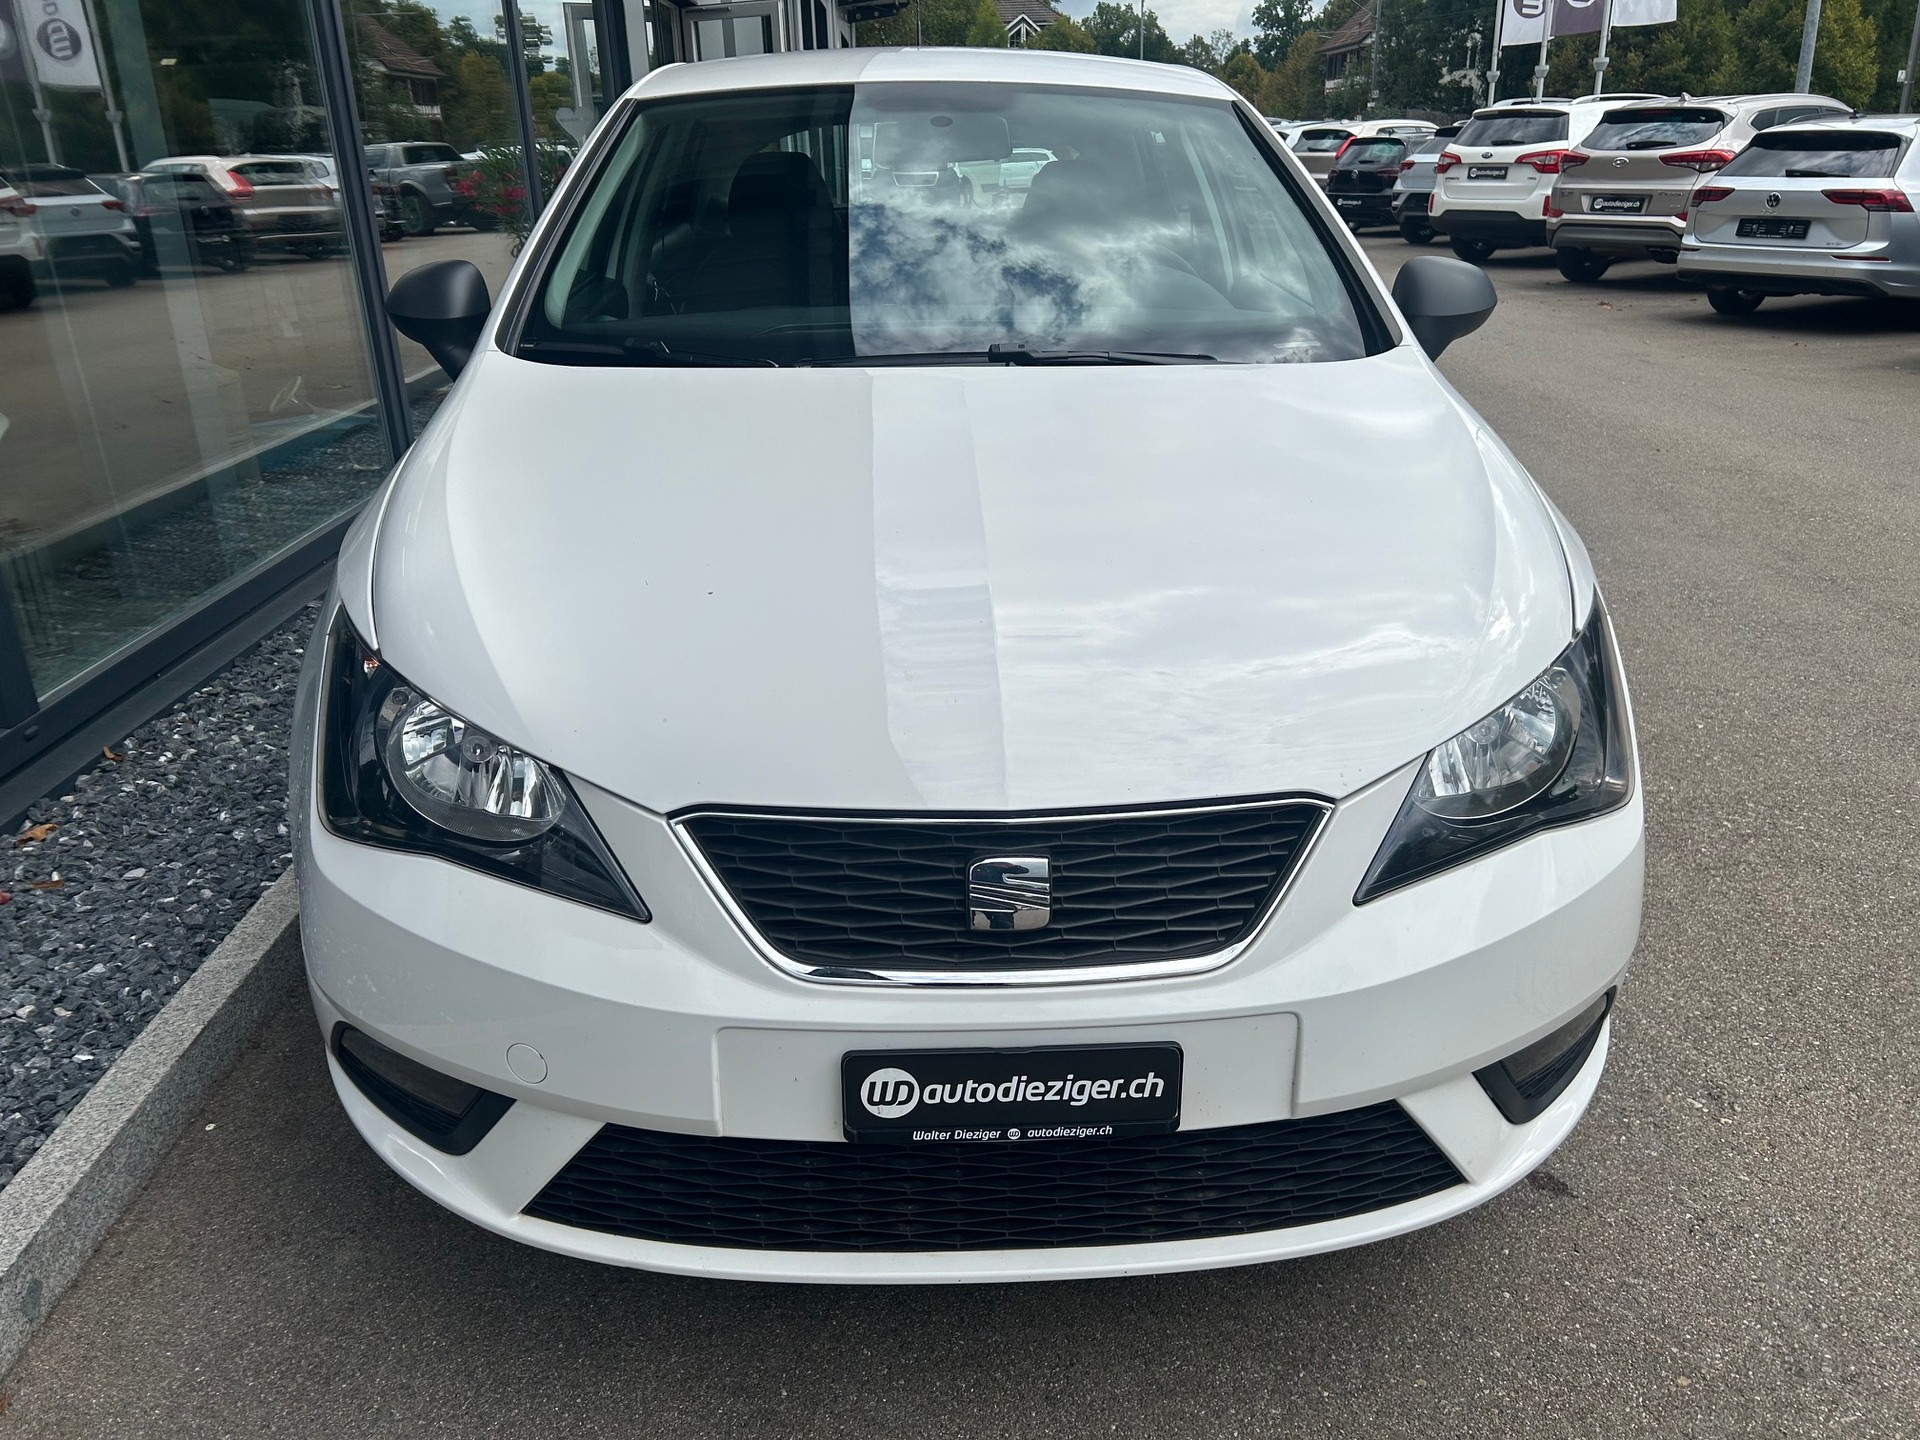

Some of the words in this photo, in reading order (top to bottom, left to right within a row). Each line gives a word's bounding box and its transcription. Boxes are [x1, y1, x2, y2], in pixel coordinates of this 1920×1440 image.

[922, 1071, 1165, 1107] autodieziger.ch
[912, 1129, 951, 1141] Walter
[954, 1128, 1002, 1141] Dieziger
[1027, 1125, 1113, 1138] autodieziger.ch
